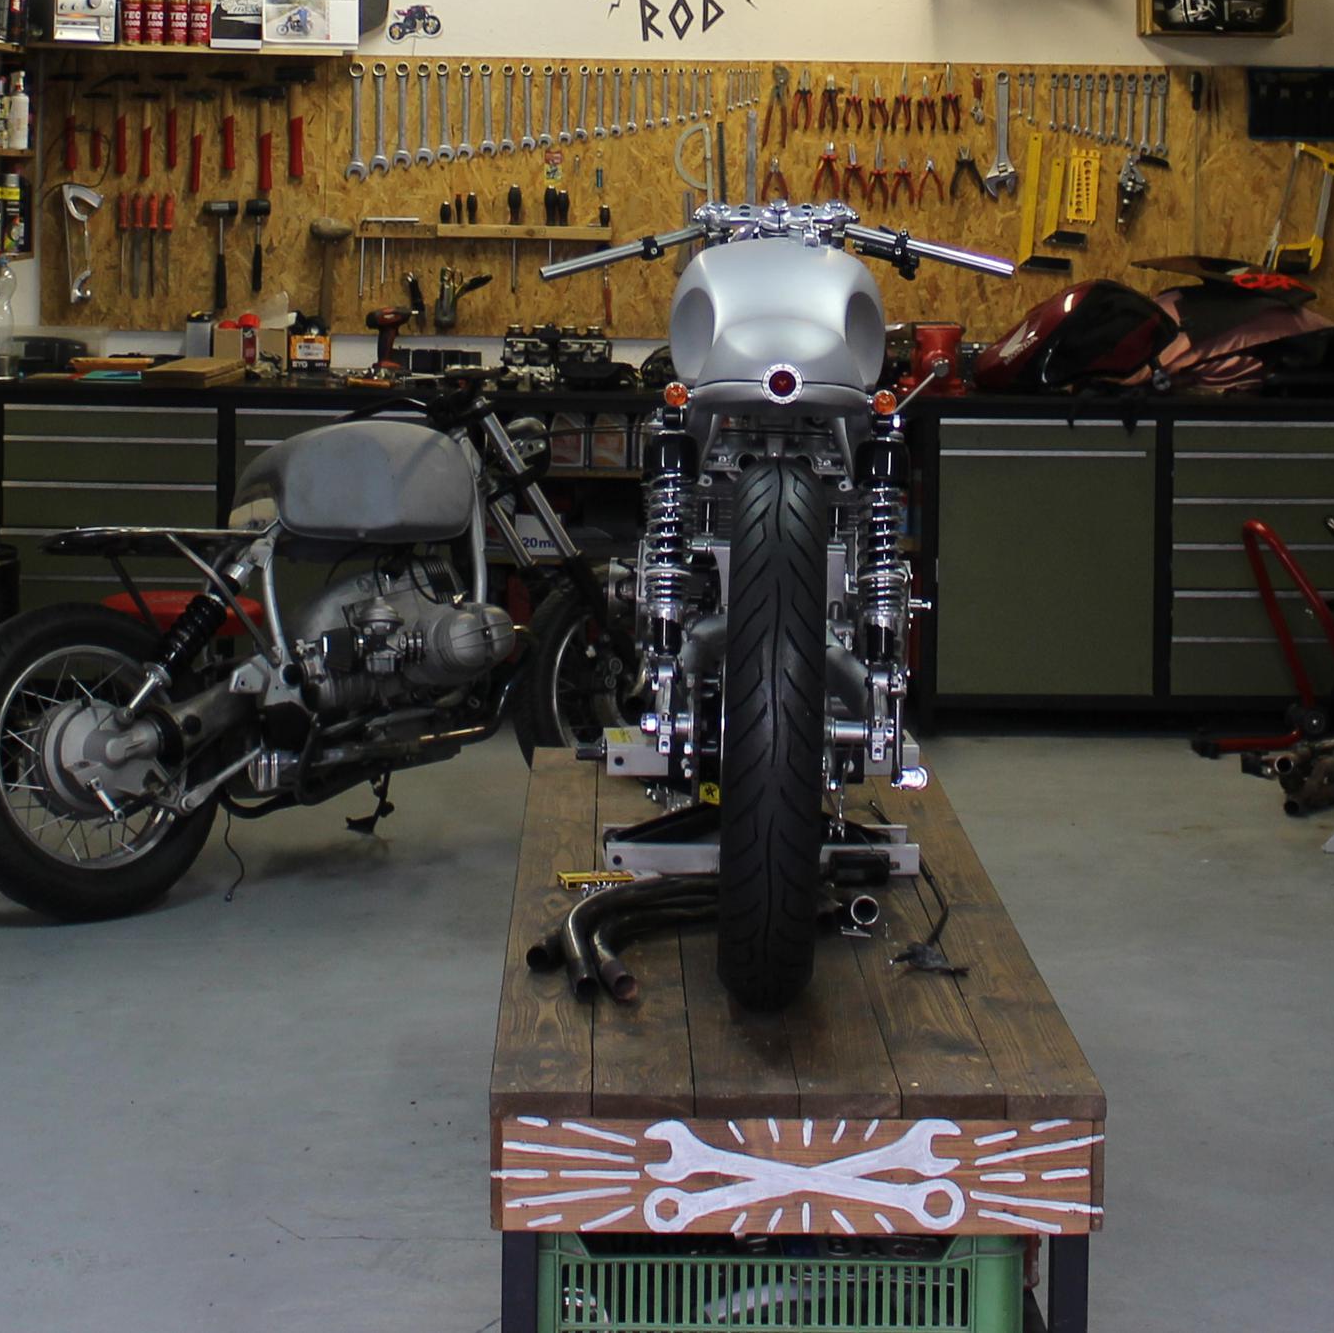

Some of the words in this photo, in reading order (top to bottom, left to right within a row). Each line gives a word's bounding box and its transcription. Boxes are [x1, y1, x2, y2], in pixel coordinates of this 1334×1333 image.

[124, 10, 141, 20] TEC
[147, 11, 164, 21] TEC
[170, 11, 188, 21] TEC
[191, 12, 208, 22] TEC
